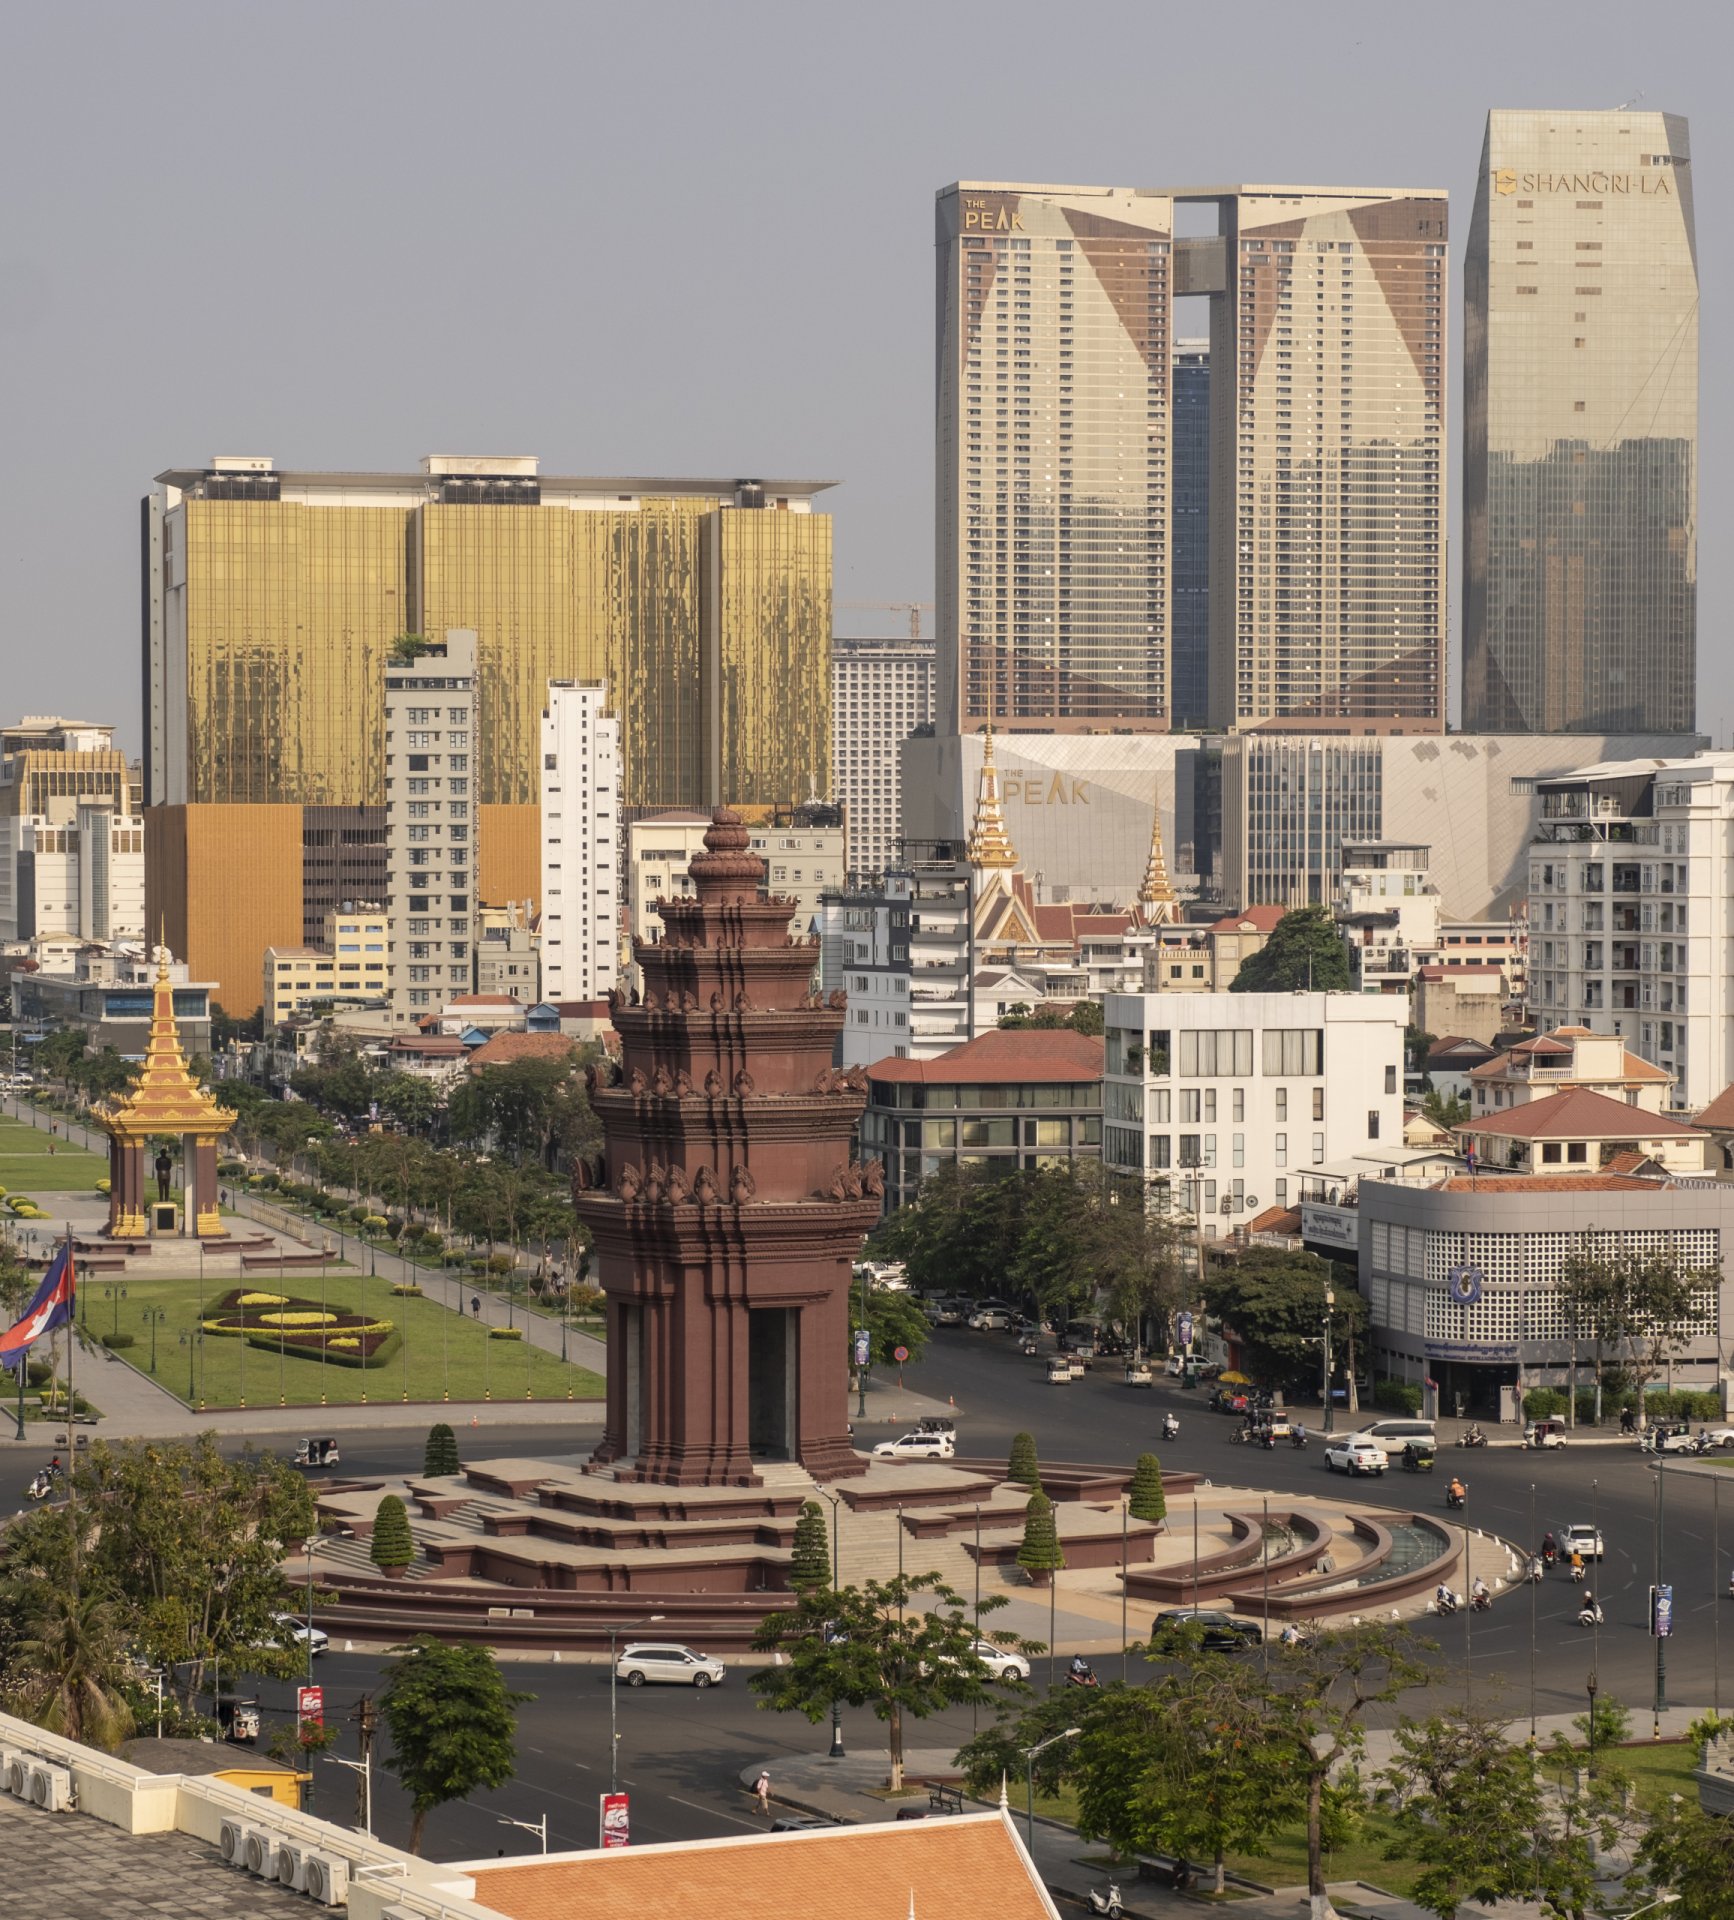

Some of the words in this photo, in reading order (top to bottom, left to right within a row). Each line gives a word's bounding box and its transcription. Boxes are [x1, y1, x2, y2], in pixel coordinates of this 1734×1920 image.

[1522, 174, 1671, 194] SHANGRI-LA
[966, 200, 985, 208] THE
[965, 204, 1024, 230] PEAK
[1004, 769, 1023, 777] THE
[1003, 769, 1090, 804] PEAK
[302, 1697, 322, 1711] 5G
